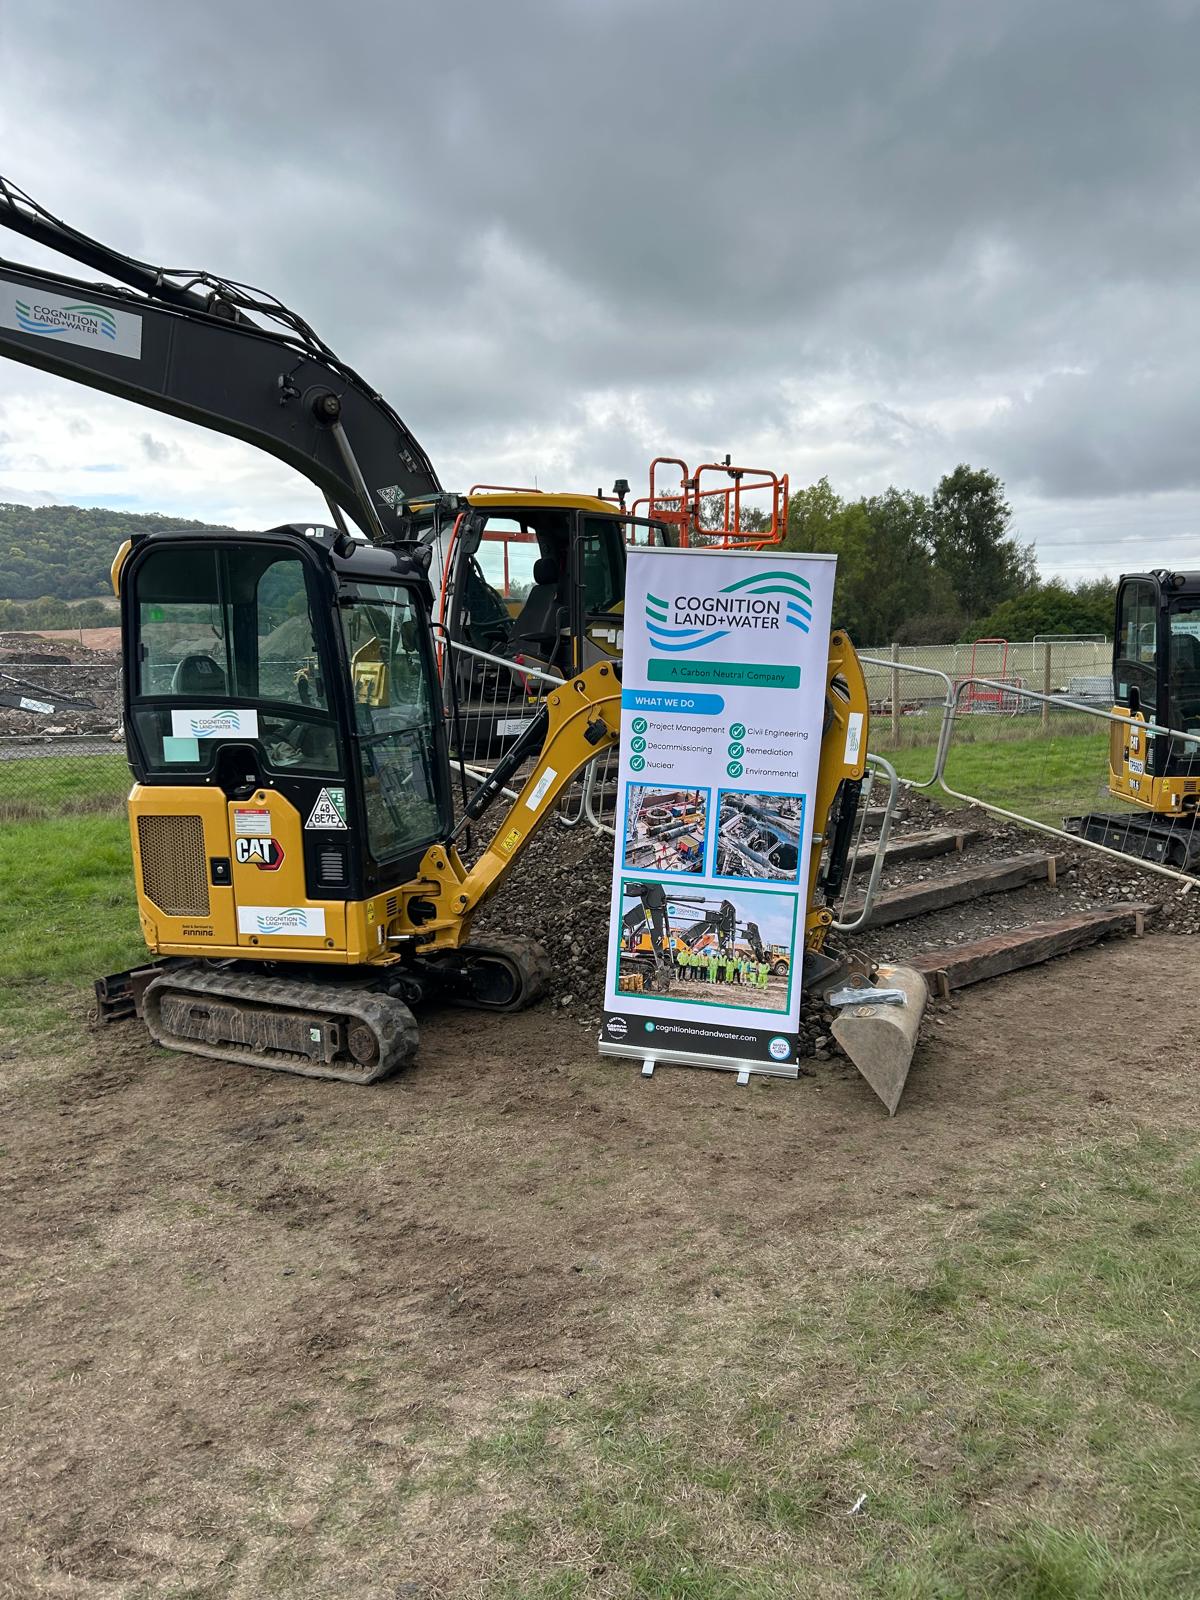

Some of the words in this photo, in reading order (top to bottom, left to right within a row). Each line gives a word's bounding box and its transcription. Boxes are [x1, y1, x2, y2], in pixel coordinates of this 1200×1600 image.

[33, 305, 98, 328] COGNITION
[34, 313, 98, 335] LAND+WATER
[674, 596, 781, 615] COGNITION
[674, 612, 780, 629] LAND+WATER
[671, 667, 678, 675] A
[680, 668, 711, 678] Carbon
[713, 670, 744, 680] Neutral
[747, 672, 785, 682] Company
[635, 696, 662, 707] WHAT
[664, 698, 679, 707] WE
[680, 699, 695, 708] DO
[649, 722, 675, 733] Project
[675, 723, 725, 735] Management
[747, 727, 764, 737] Civil
[764, 729, 809, 740] Engineering
[648, 741, 713, 754] Decommissioning
[746, 746, 794, 757] Remediation
[646, 760, 675, 770] Nuclear
[745, 767, 799, 779] Environmental
[319, 803, 331, 814] 48
[314, 813, 337, 824] BE7E
[236, 838, 272, 863] CAT
[655, 1023, 758, 1042] cognitionlandandwater.com
